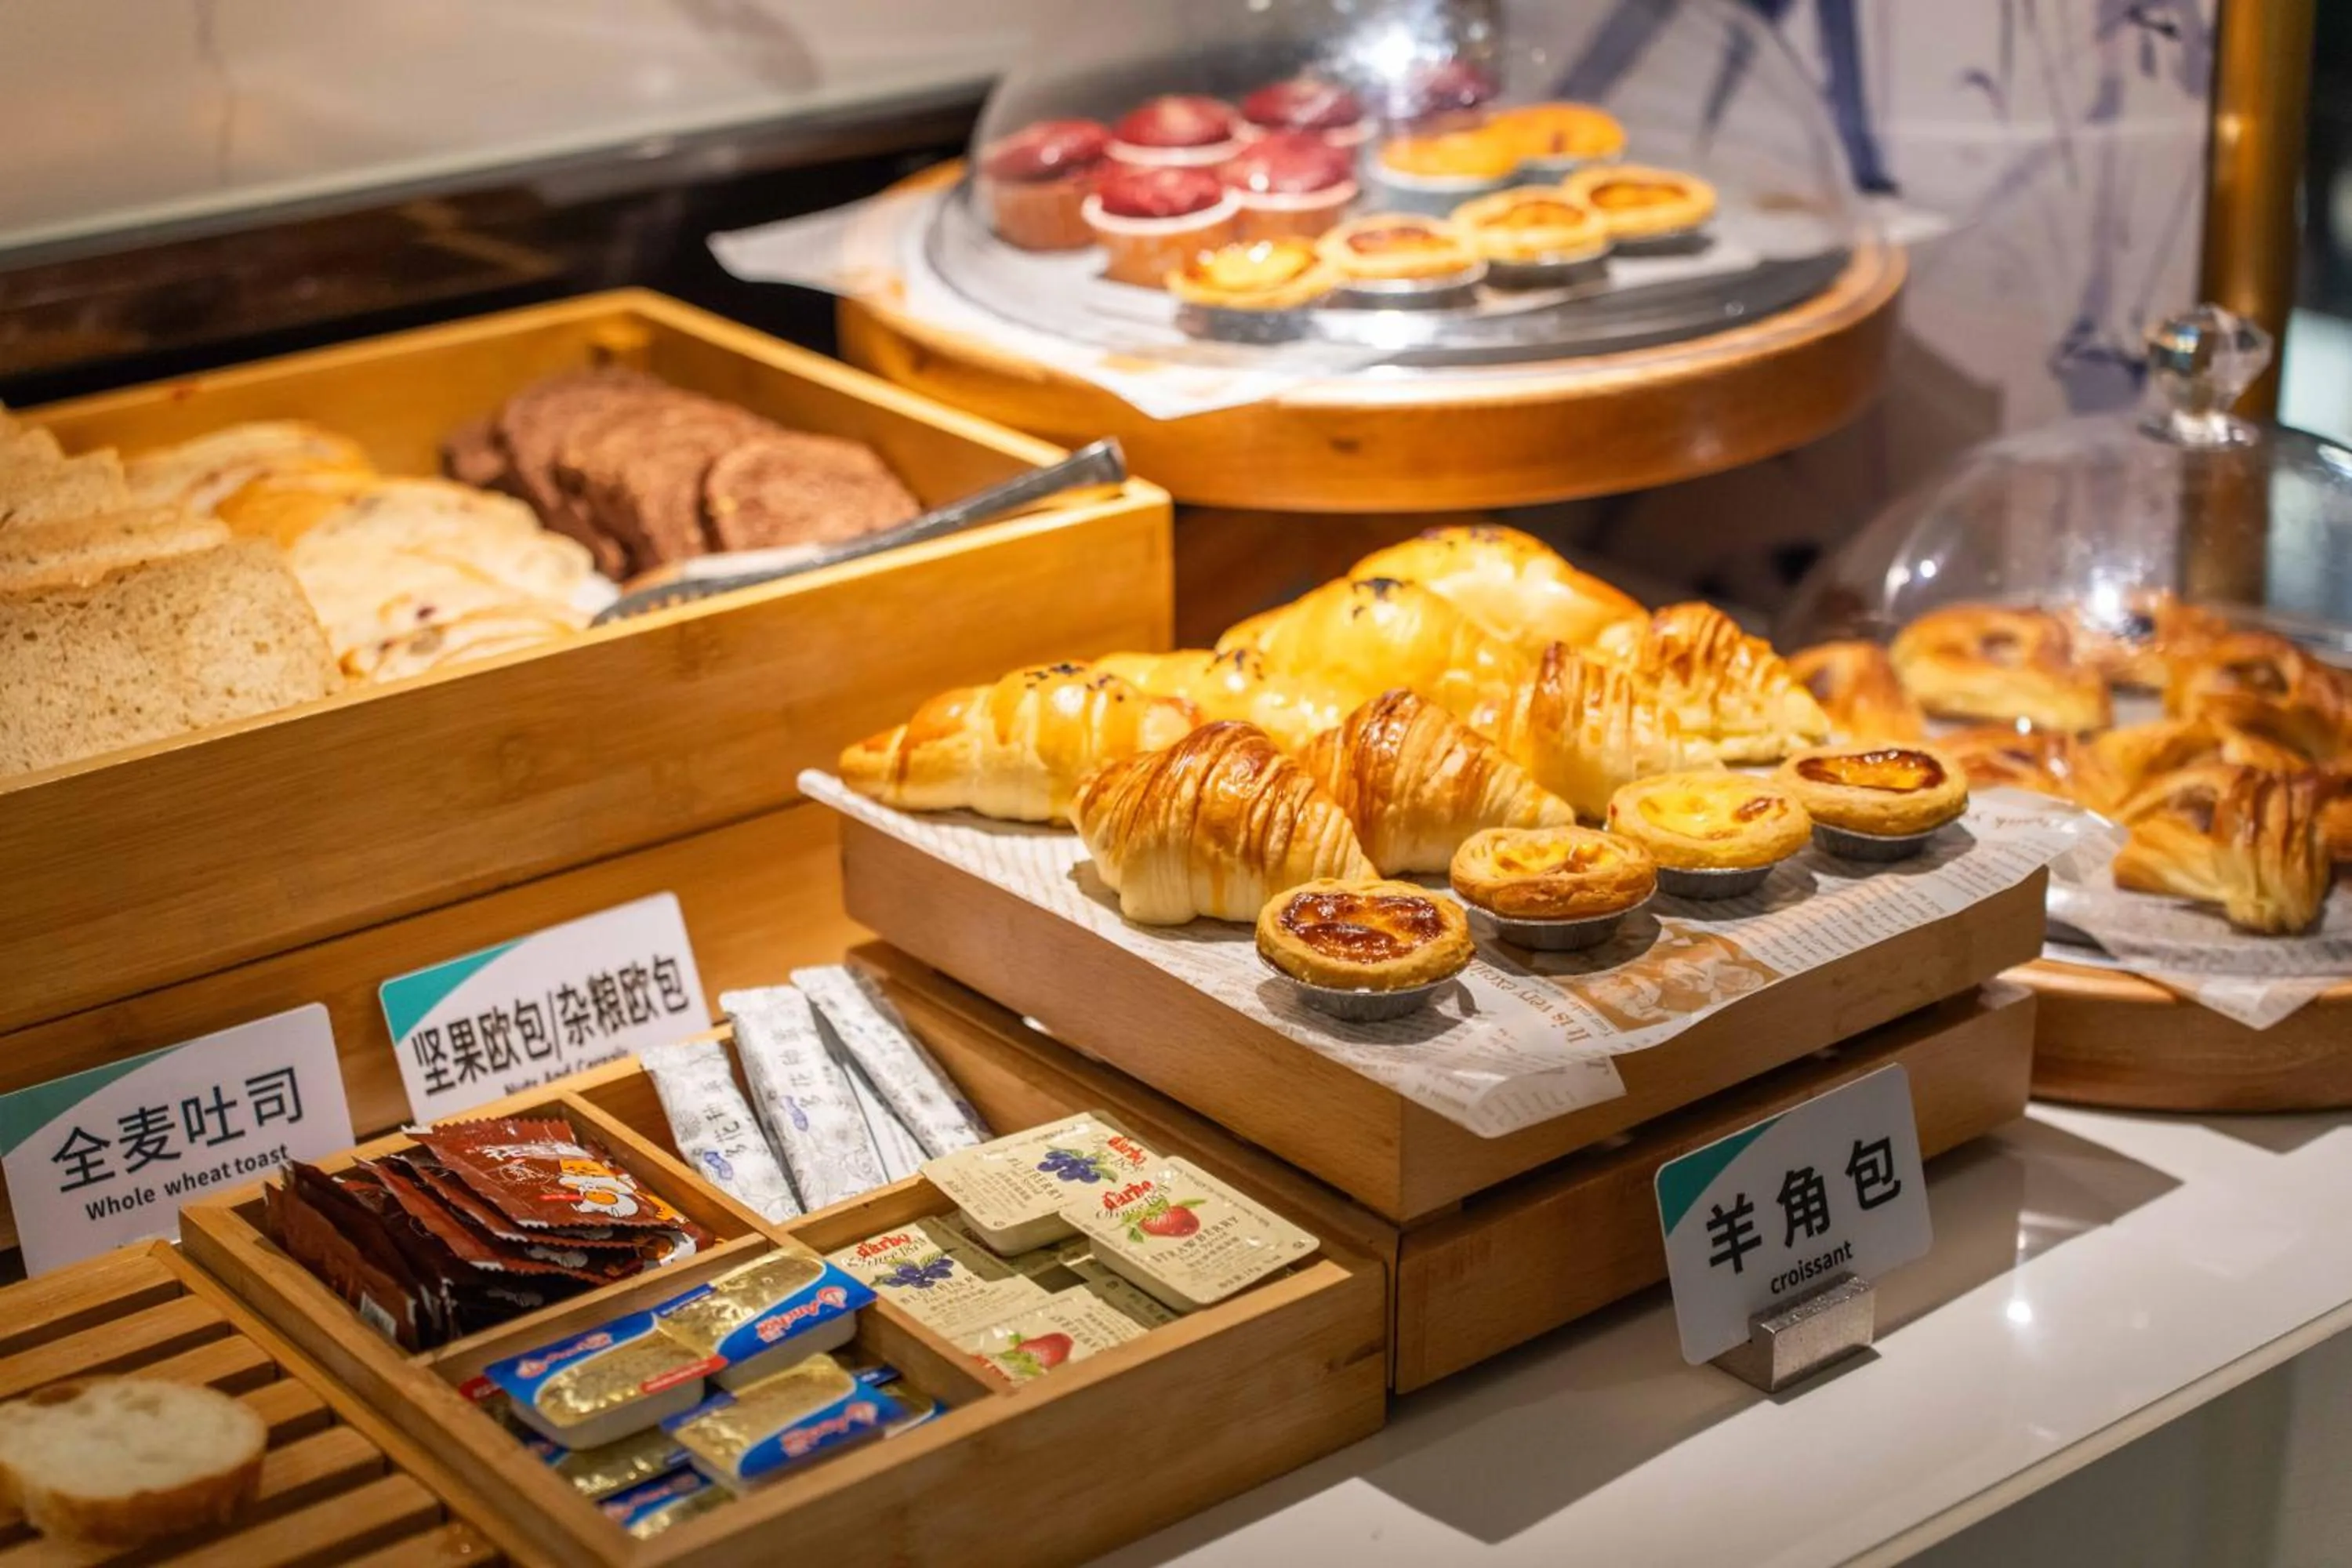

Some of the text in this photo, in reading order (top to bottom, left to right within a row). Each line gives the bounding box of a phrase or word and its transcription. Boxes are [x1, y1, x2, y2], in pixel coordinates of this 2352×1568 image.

[50, 1065, 305, 1193] 全麦吐司
[85, 1143, 290, 1221] Whole wheat toast
[1705, 1135, 1902, 1276] 羊角包
[1770, 1240, 1855, 1295] croissant
